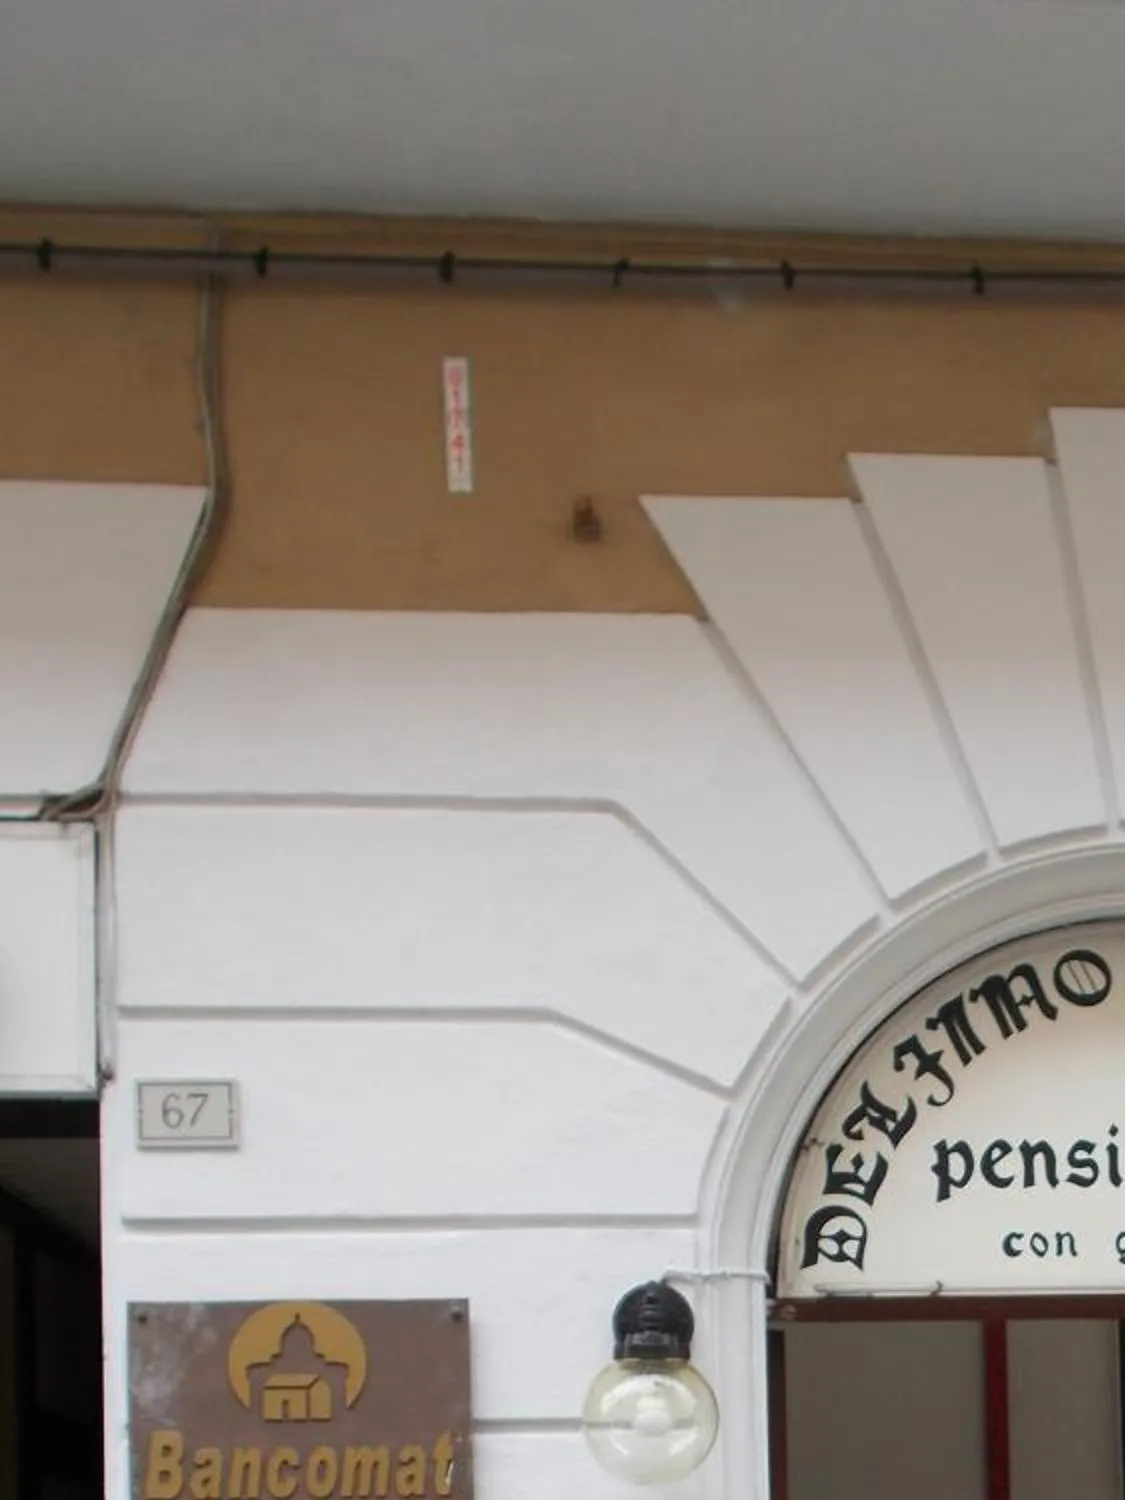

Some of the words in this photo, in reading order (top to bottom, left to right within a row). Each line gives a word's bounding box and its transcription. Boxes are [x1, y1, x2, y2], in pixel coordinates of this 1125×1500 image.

[161, 1091, 210, 1129] 67
[800, 948, 1113, 1271] DELFINO
[1002, 1231, 1078, 1258] con
